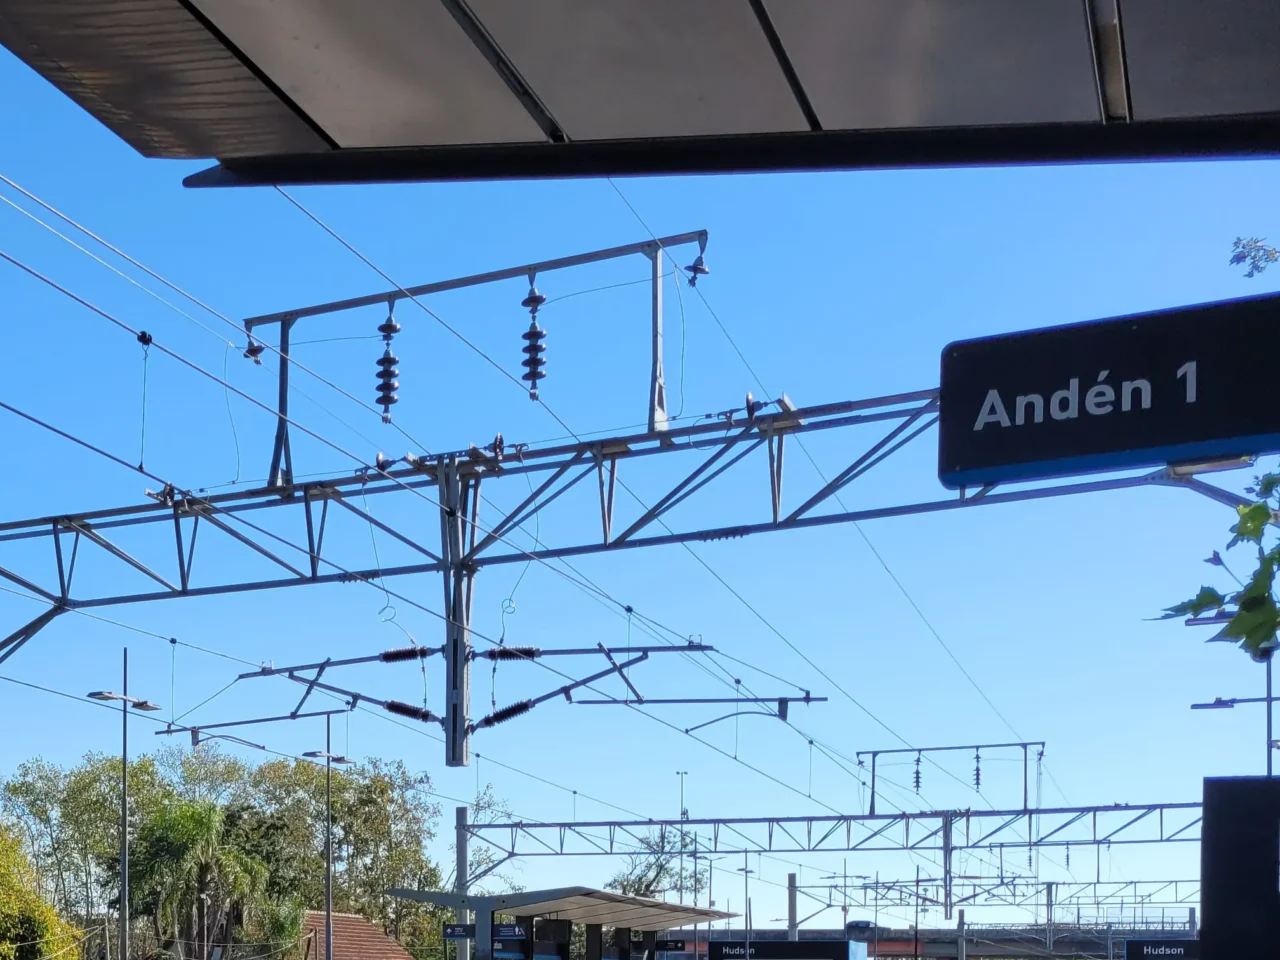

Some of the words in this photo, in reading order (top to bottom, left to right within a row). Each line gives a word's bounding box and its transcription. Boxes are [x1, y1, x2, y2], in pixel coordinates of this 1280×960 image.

[972, 369, 1152, 431] Andén
[1176, 361, 1198, 404] 1
[1143, 945, 1184, 955] Hudson
